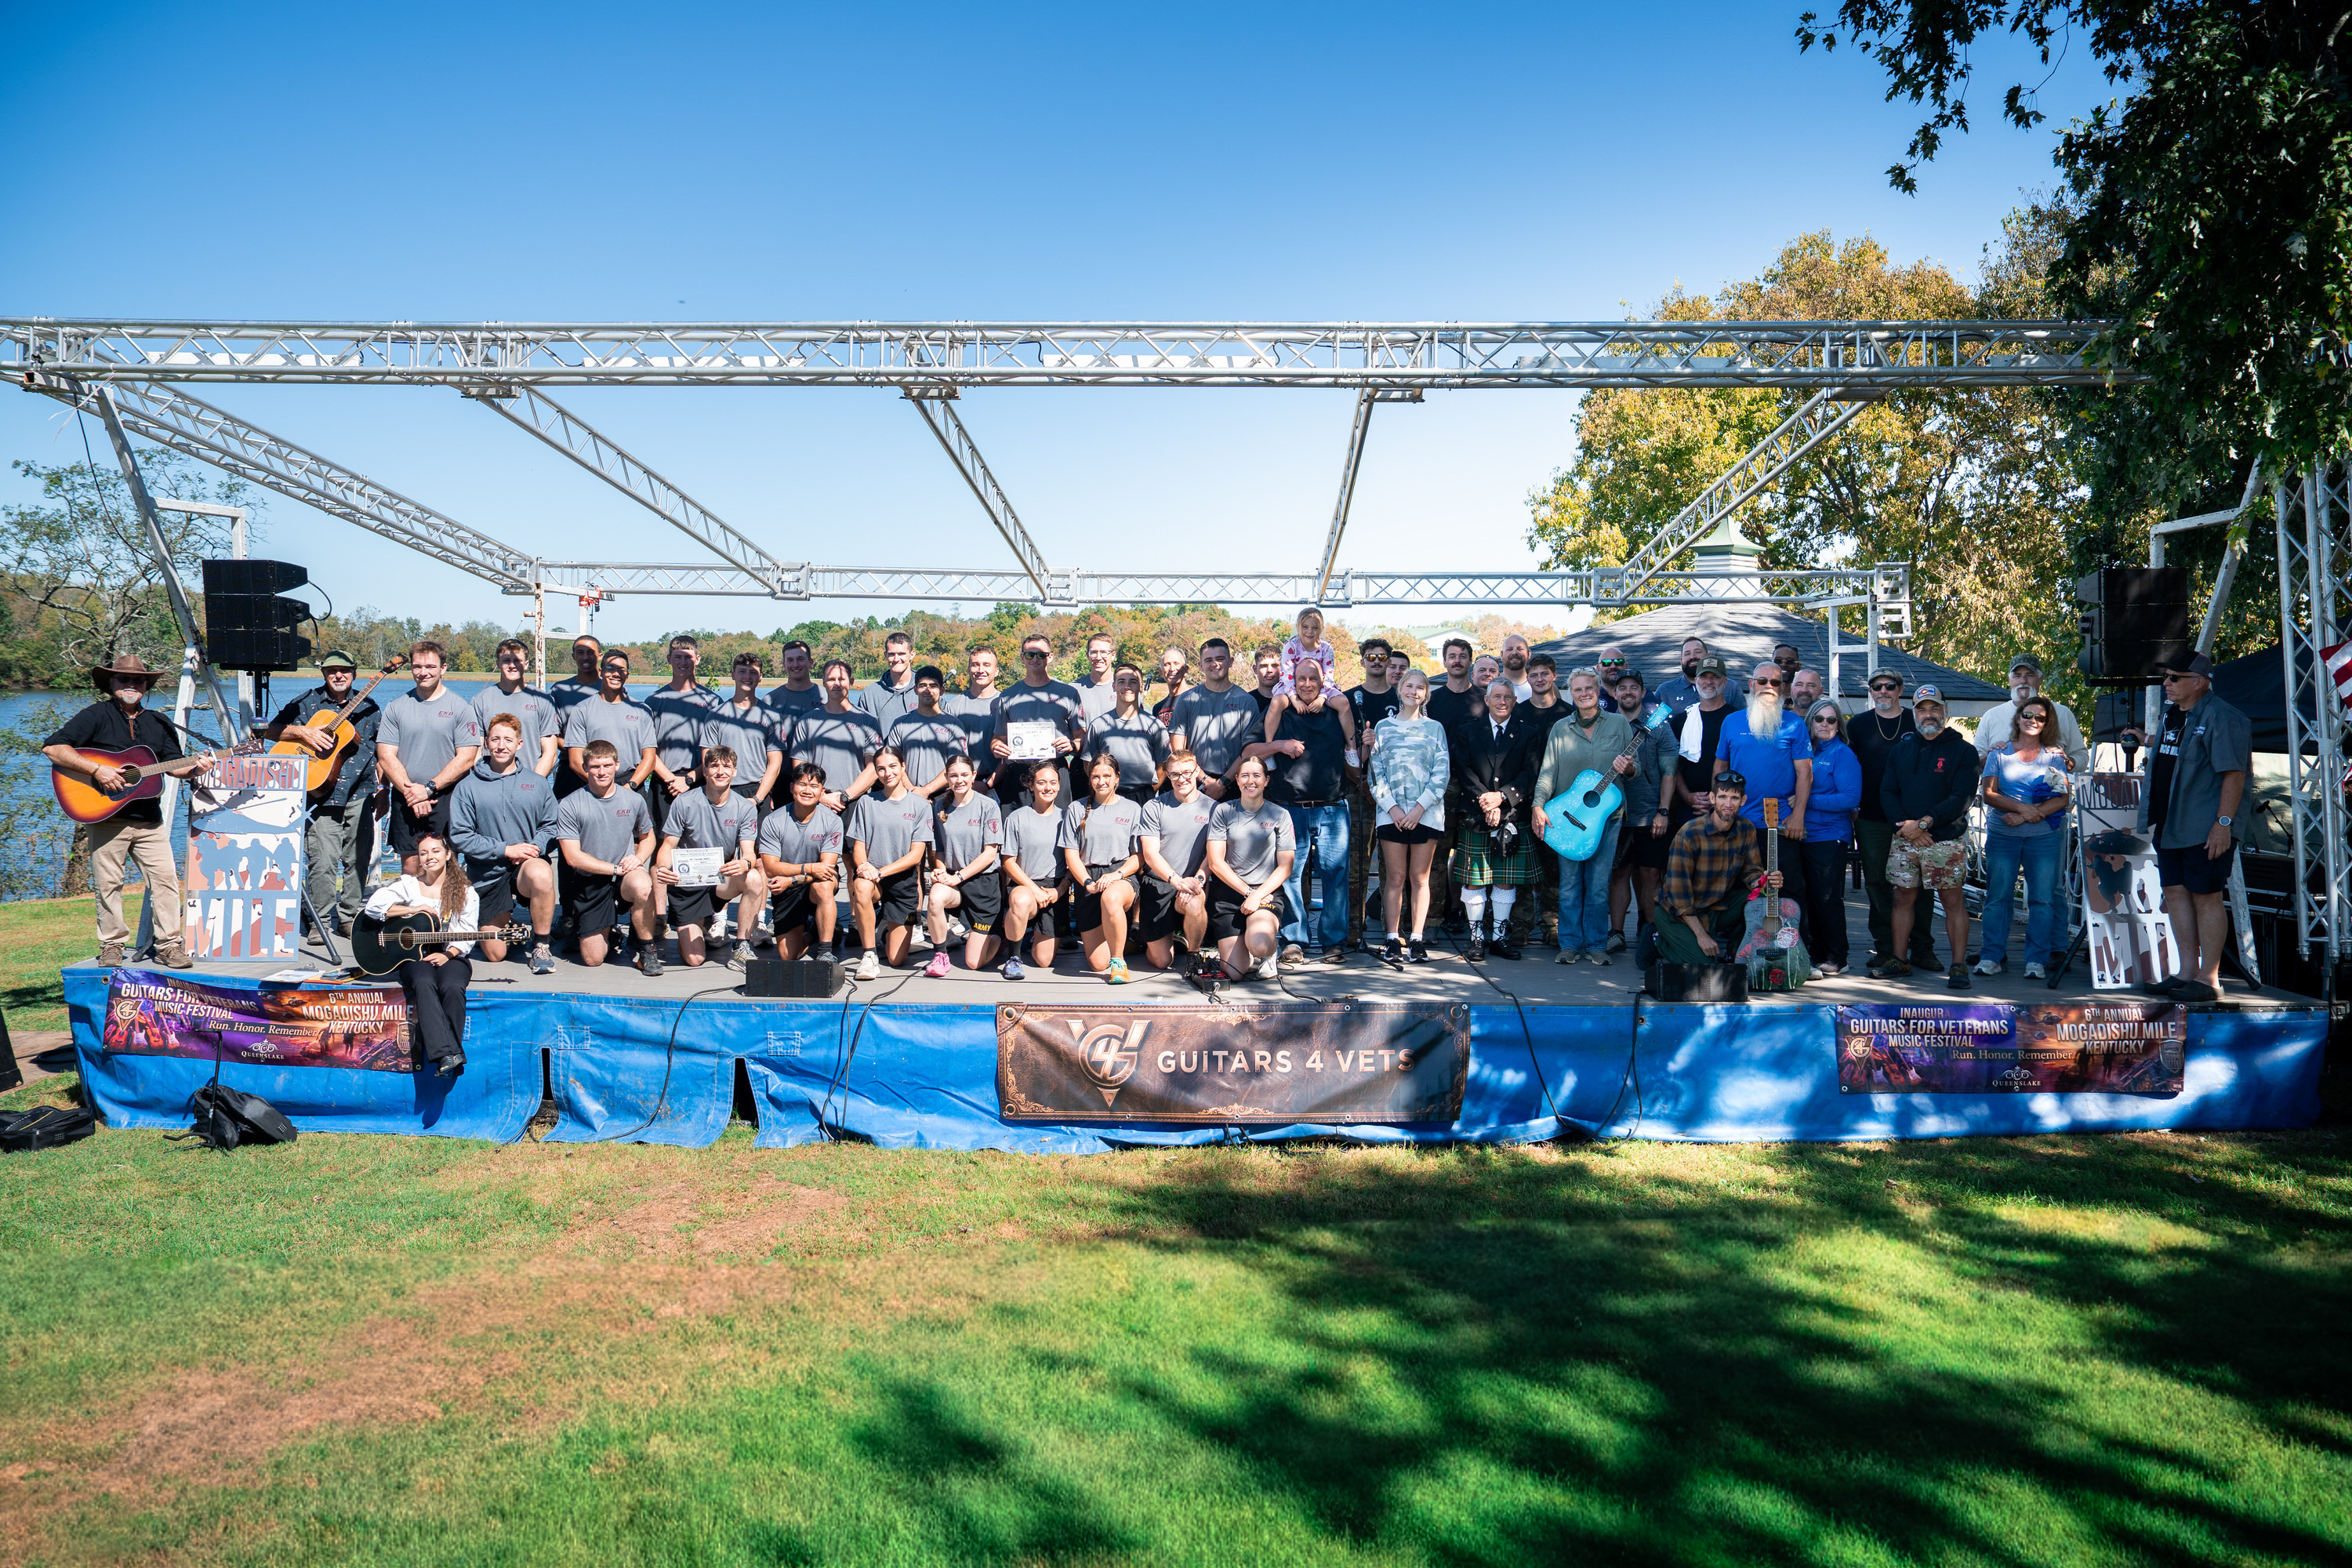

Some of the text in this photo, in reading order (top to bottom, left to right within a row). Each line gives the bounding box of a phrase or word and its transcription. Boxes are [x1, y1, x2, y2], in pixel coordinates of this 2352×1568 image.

[2169, 746, 2179, 756] MIL
[2079, 779, 2141, 808] MOGAD
[184, 898, 297, 957] MILE
[974, 922, 992, 931] ARMY
[2092, 922, 2170, 984] MIL
[121, 982, 259, 1012] GUITARS FOR VETERANS
[328, 992, 387, 1004] 6TH ANNUAL
[154, 1000, 234, 1019] MUSIC FESTIVAL
[302, 1004, 414, 1022] MOGADISHU MILE
[2084, 1007, 2145, 1022] 6TH ANNUAL
[208, 1020, 319, 1037] Run. Honor. Remember.
[328, 1021, 384, 1034] KENTUCKY
[1850, 1018, 2009, 1035] GUITARS FOR VETERANS
[2056, 1022, 2178, 1041] MOGADISHU MILE
[1888, 1035, 1975, 1047] MUSIC FESTIVAL
[2085, 1040, 2145, 1054] KENTUCKY
[1157, 1048, 1415, 1074] GUITARS 4 VETS
[1952, 1050, 2075, 1059] Run. Honor. Remember.
